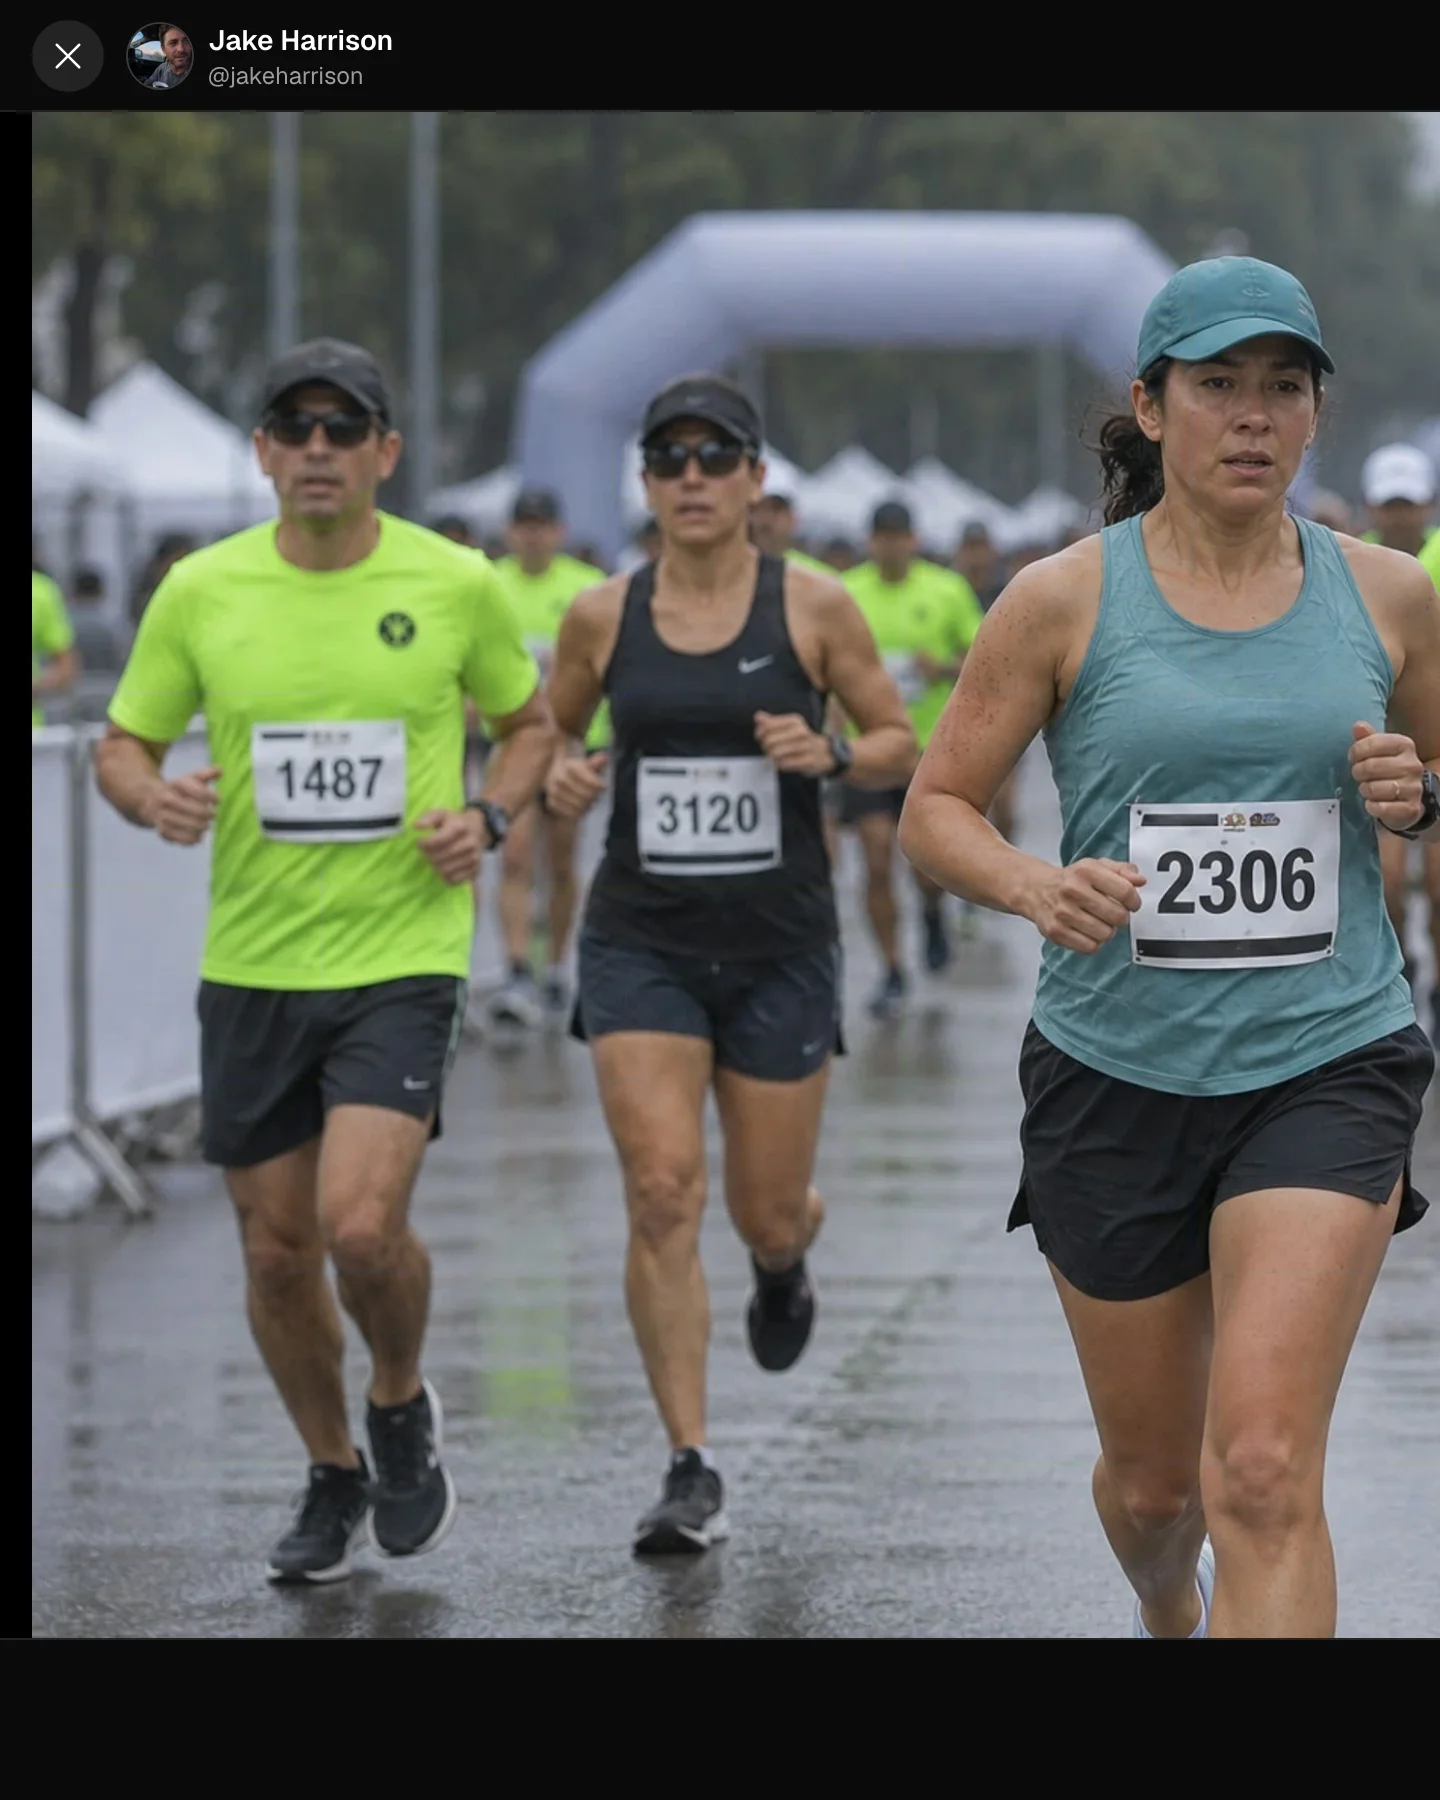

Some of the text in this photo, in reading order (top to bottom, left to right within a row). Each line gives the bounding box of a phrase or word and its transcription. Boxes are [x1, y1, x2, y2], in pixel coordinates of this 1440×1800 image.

[209, 29, 392, 52] Jake Harrison
[208, 66, 363, 89] @jakeharrison
[276, 757, 383, 800] 1487
[656, 793, 760, 835] 3120
[1156, 847, 1315, 914] 2306
